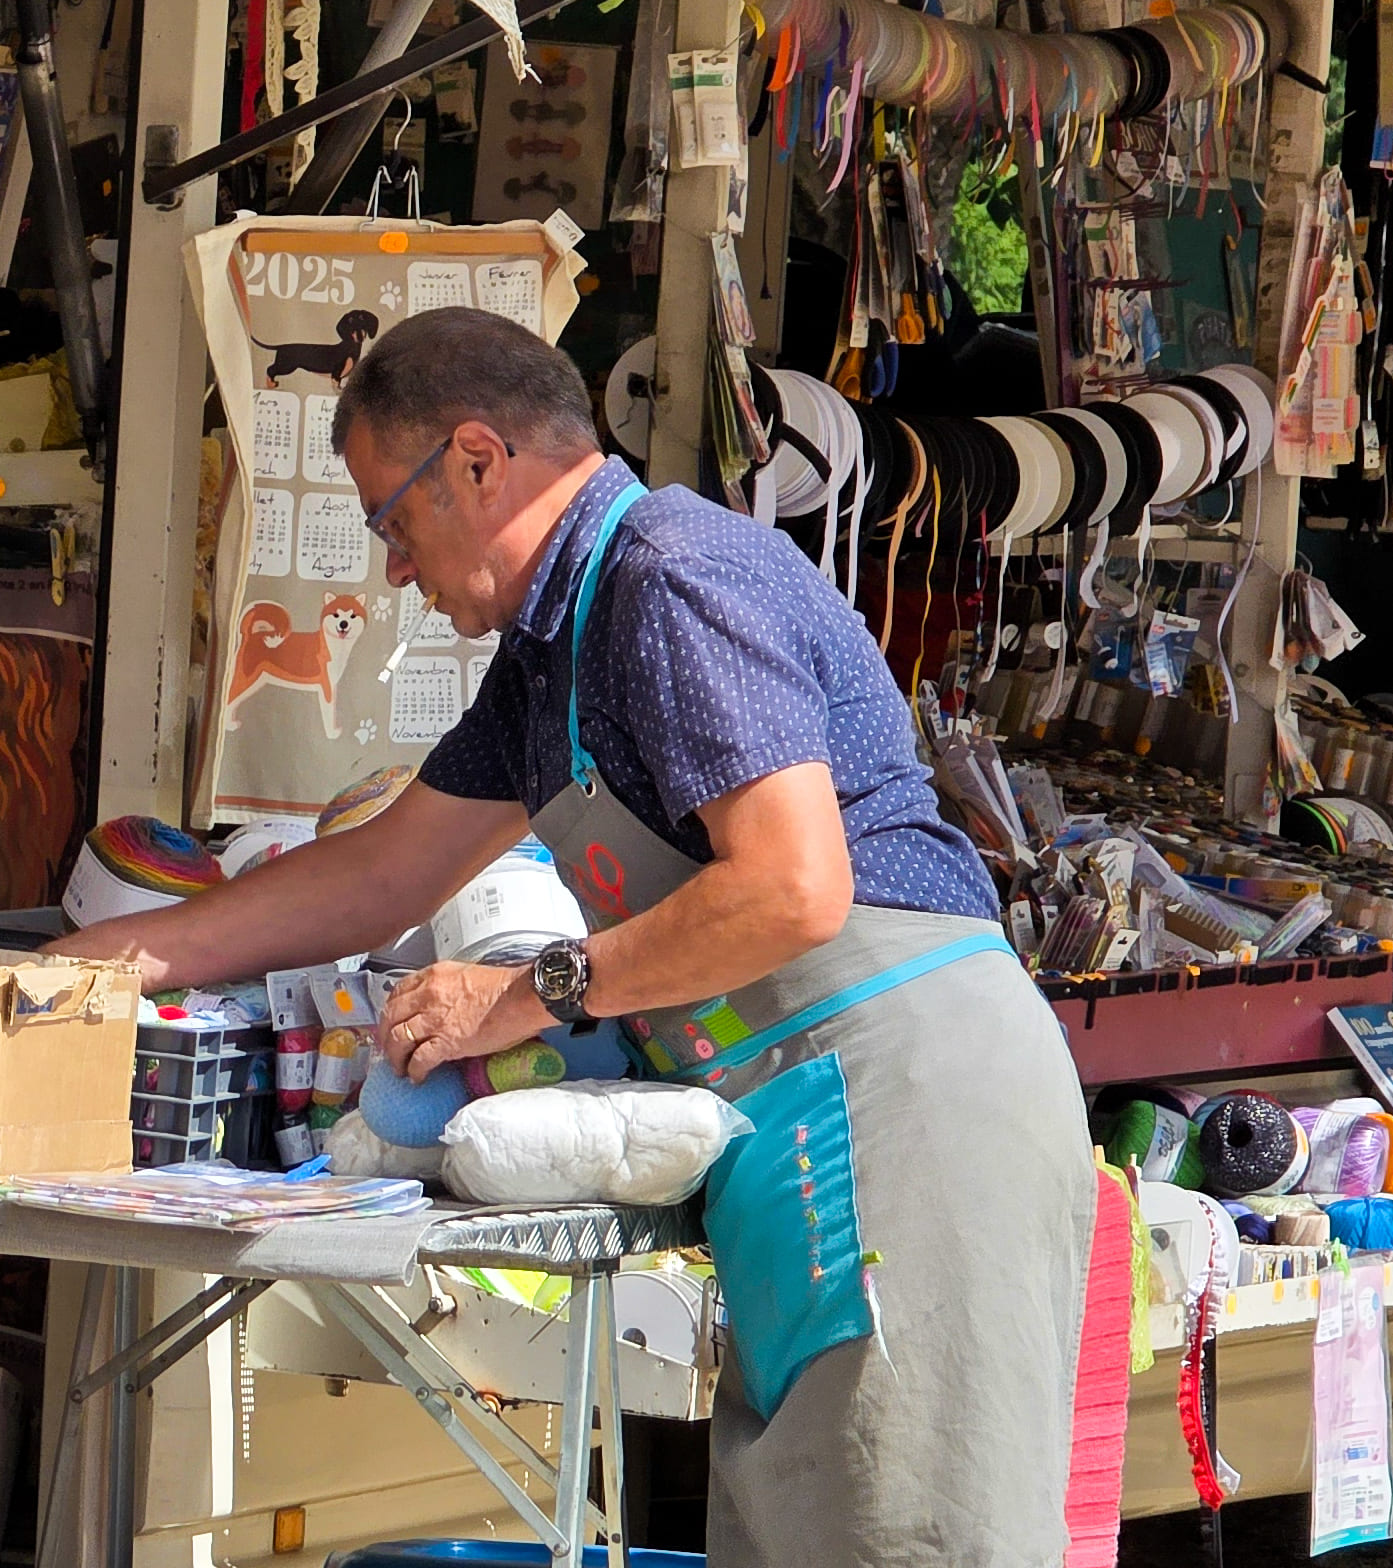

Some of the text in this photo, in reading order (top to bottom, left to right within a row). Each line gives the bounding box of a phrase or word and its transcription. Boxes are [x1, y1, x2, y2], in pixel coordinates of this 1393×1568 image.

[243, 251, 355, 306] 2025
[311, 556, 352, 578] August
[395, 661, 457, 675] Novembre
[391, 724, 445, 739] Novemb
